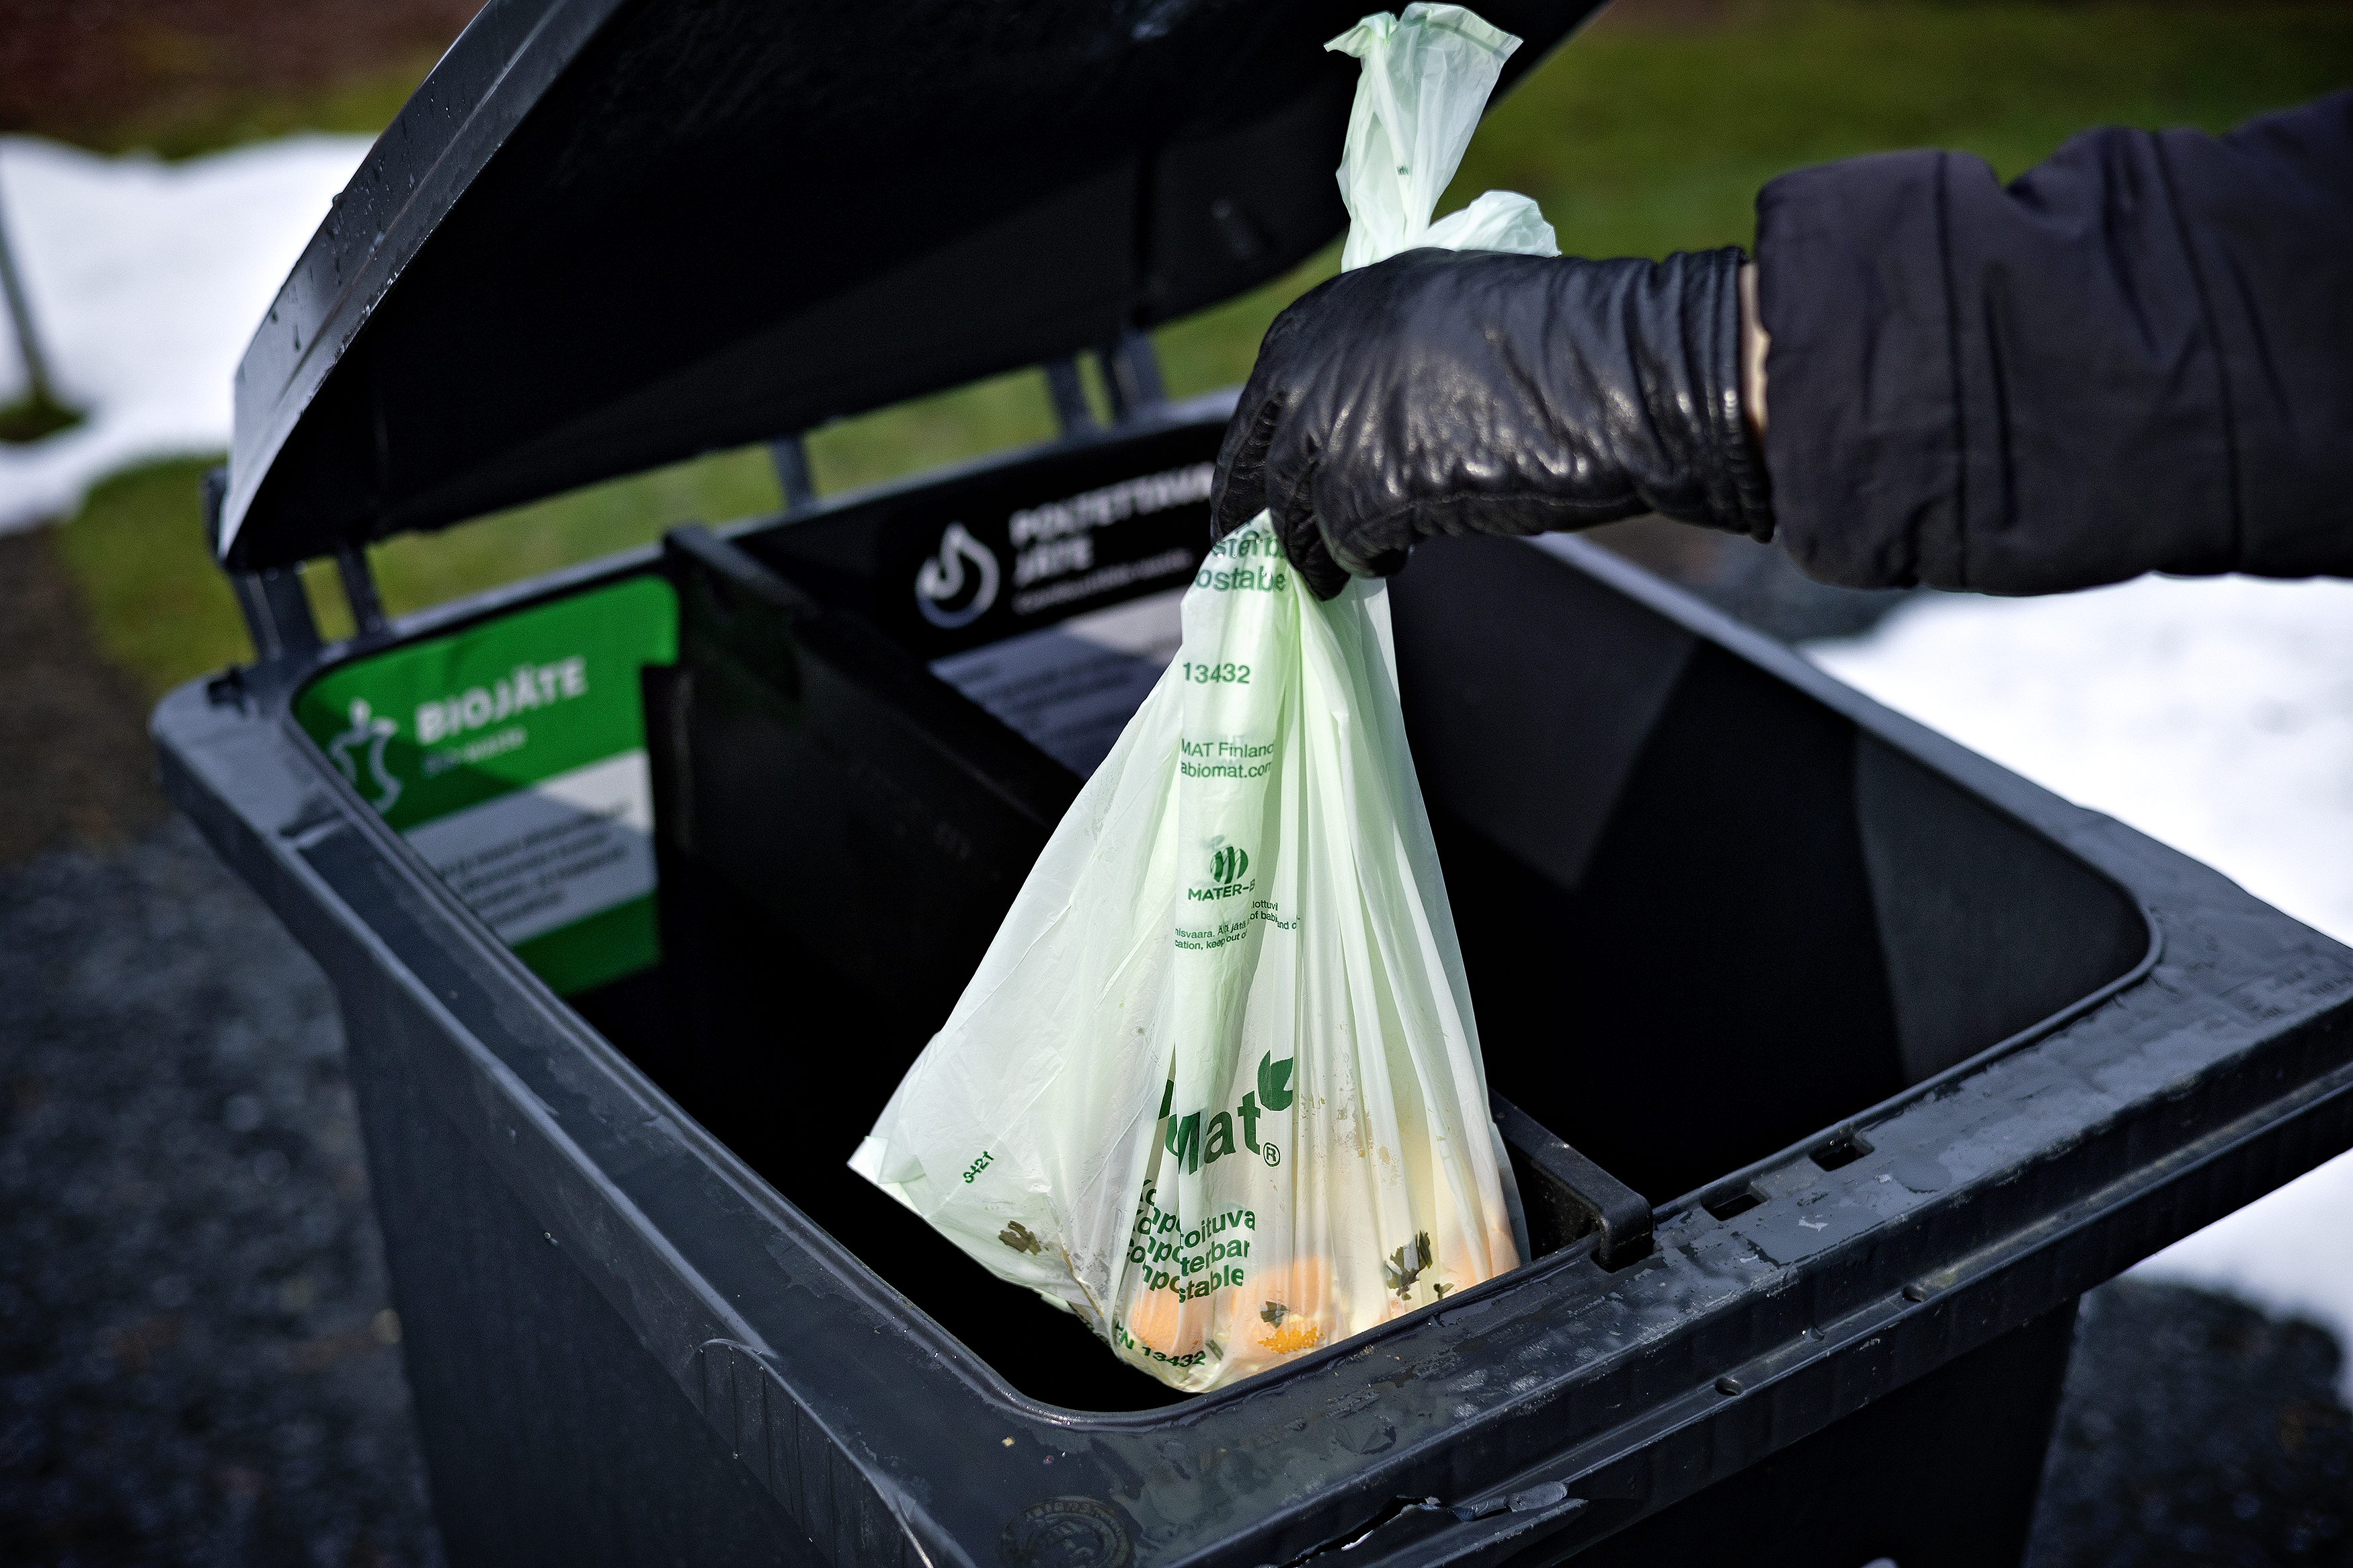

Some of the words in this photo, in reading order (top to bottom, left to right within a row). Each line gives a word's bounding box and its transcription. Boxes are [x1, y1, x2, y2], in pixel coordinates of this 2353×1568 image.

[1183, 663, 1250, 684] 13432
[416, 656, 587, 744] BIOJÄTE
[1226, 932, 1240, 942] out
[1142, 1346, 1207, 1368] 13432
